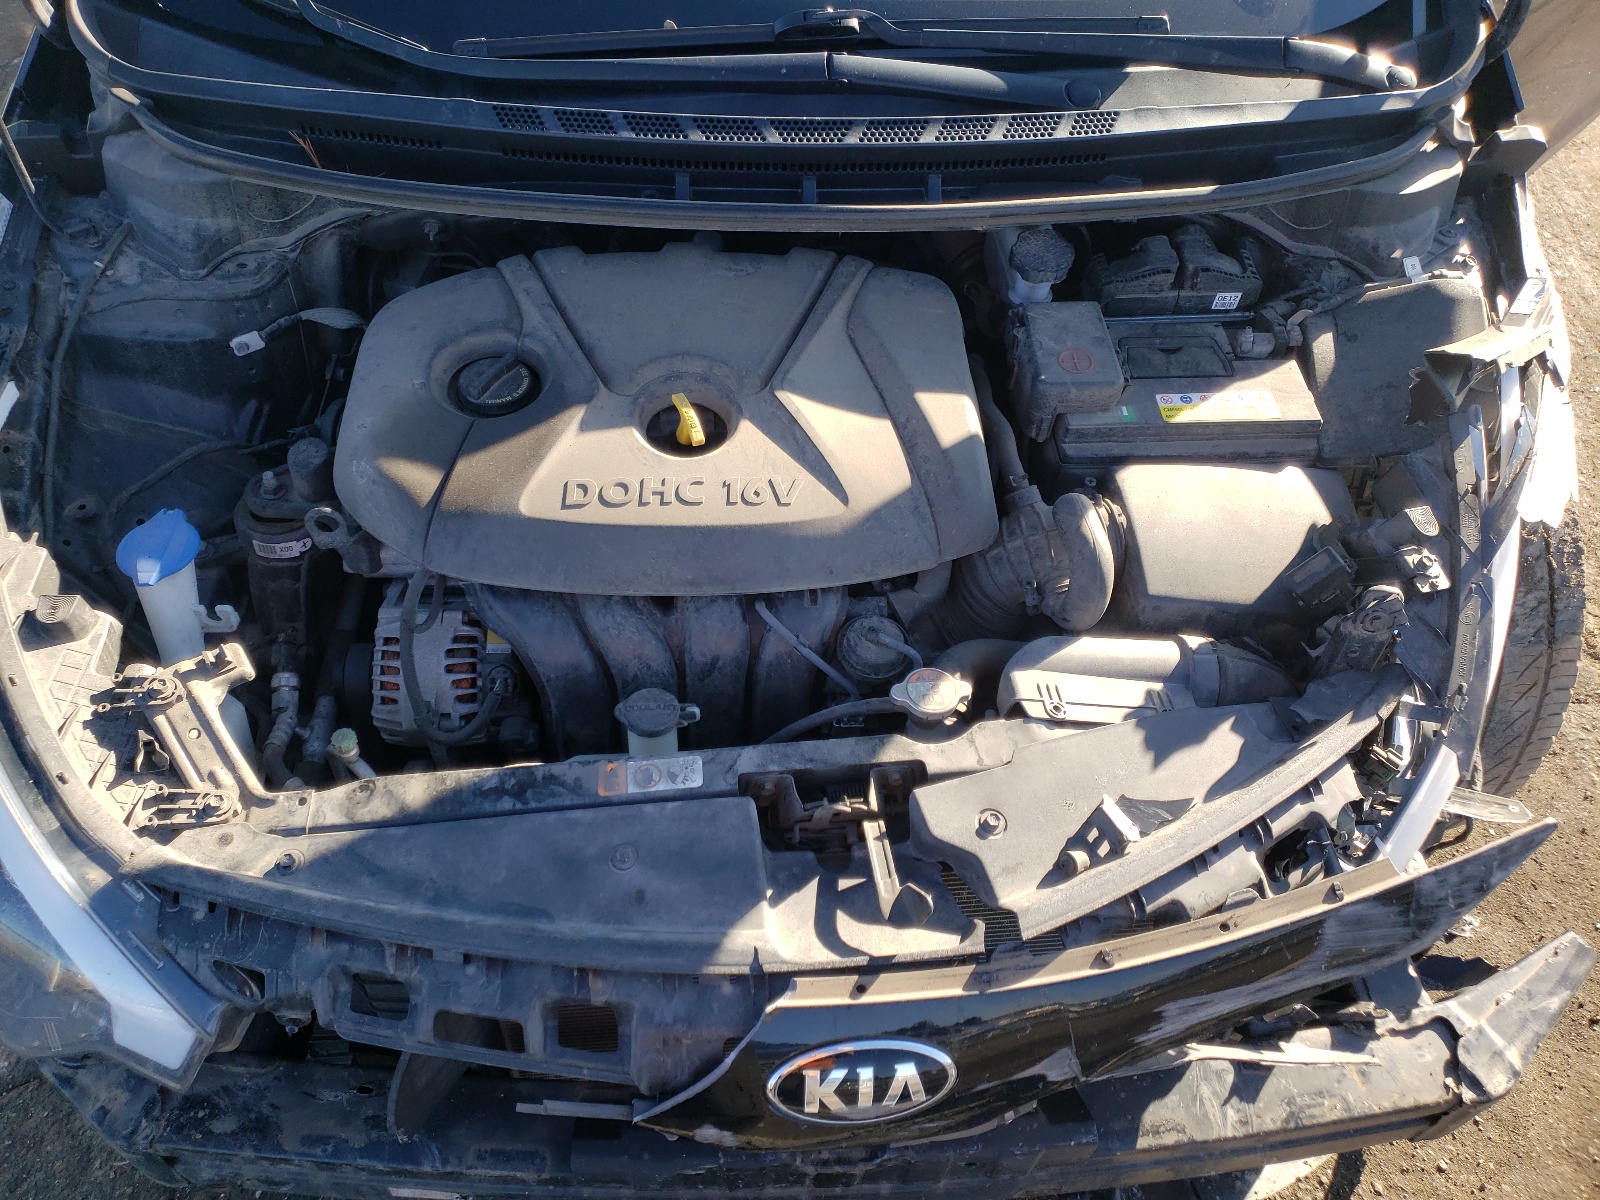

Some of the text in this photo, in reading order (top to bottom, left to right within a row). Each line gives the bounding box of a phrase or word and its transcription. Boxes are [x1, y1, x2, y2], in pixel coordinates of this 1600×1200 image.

[560, 476, 805, 510] DOHC 16V
[623, 703, 680, 713] COOLANT
[802, 1061, 926, 1114] KIA
